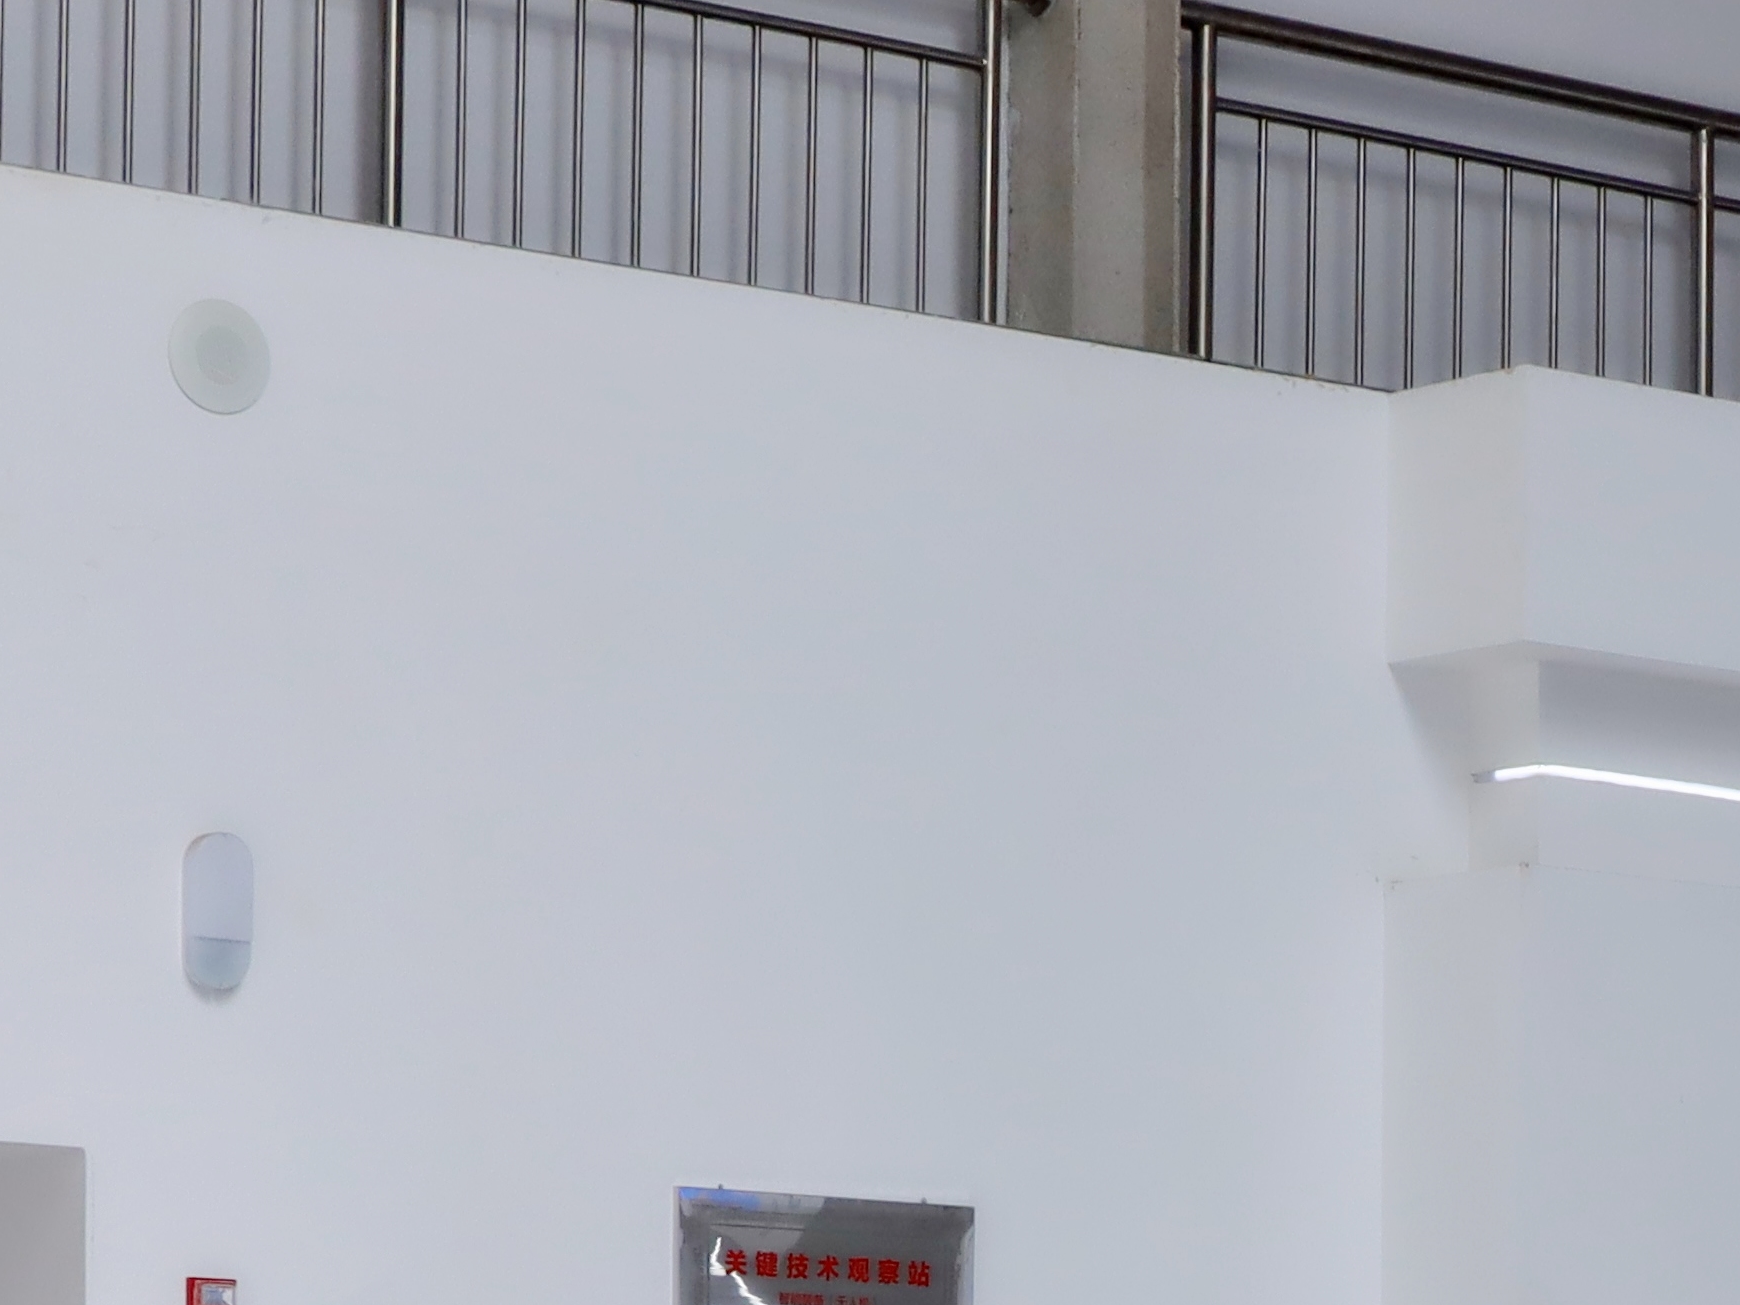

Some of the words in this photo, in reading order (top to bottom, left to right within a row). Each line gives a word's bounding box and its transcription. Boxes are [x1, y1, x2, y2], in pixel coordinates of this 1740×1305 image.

[725, 1250, 933, 1287] 关键技术观察站
